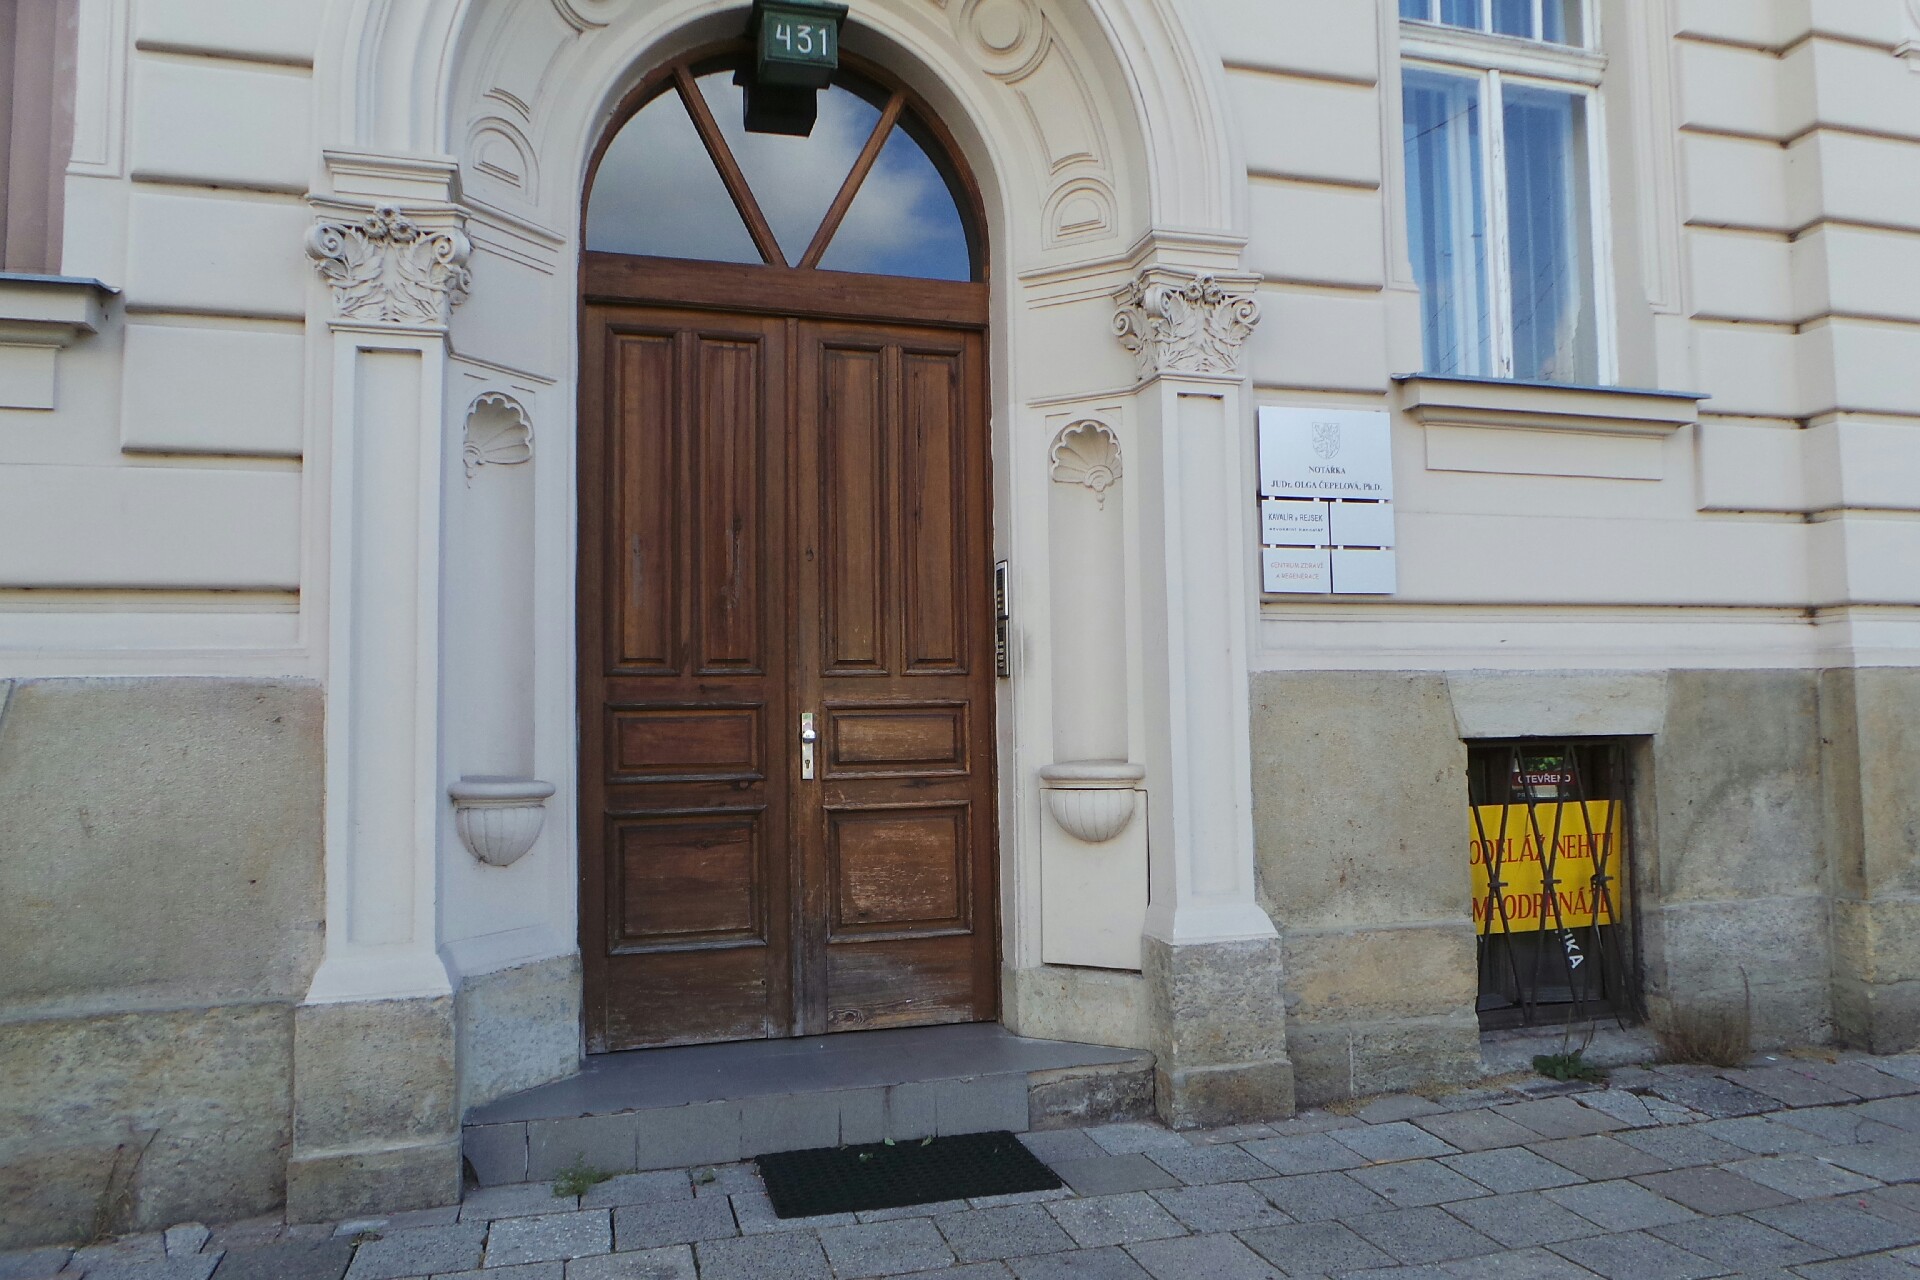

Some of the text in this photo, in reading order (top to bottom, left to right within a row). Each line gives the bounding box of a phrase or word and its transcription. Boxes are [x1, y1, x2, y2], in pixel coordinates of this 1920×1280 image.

[776, 24, 826, 56] 431
[1308, 465, 1346, 474] NOTÁŘKA
[1271, 480, 1292, 488] JUDr.
[1294, 481, 1317, 489] OLGA
[1268, 513, 1293, 521] KAVALÍR
[1299, 514, 1323, 522] REJSEK
[1559, 929, 1584, 969] IKA
